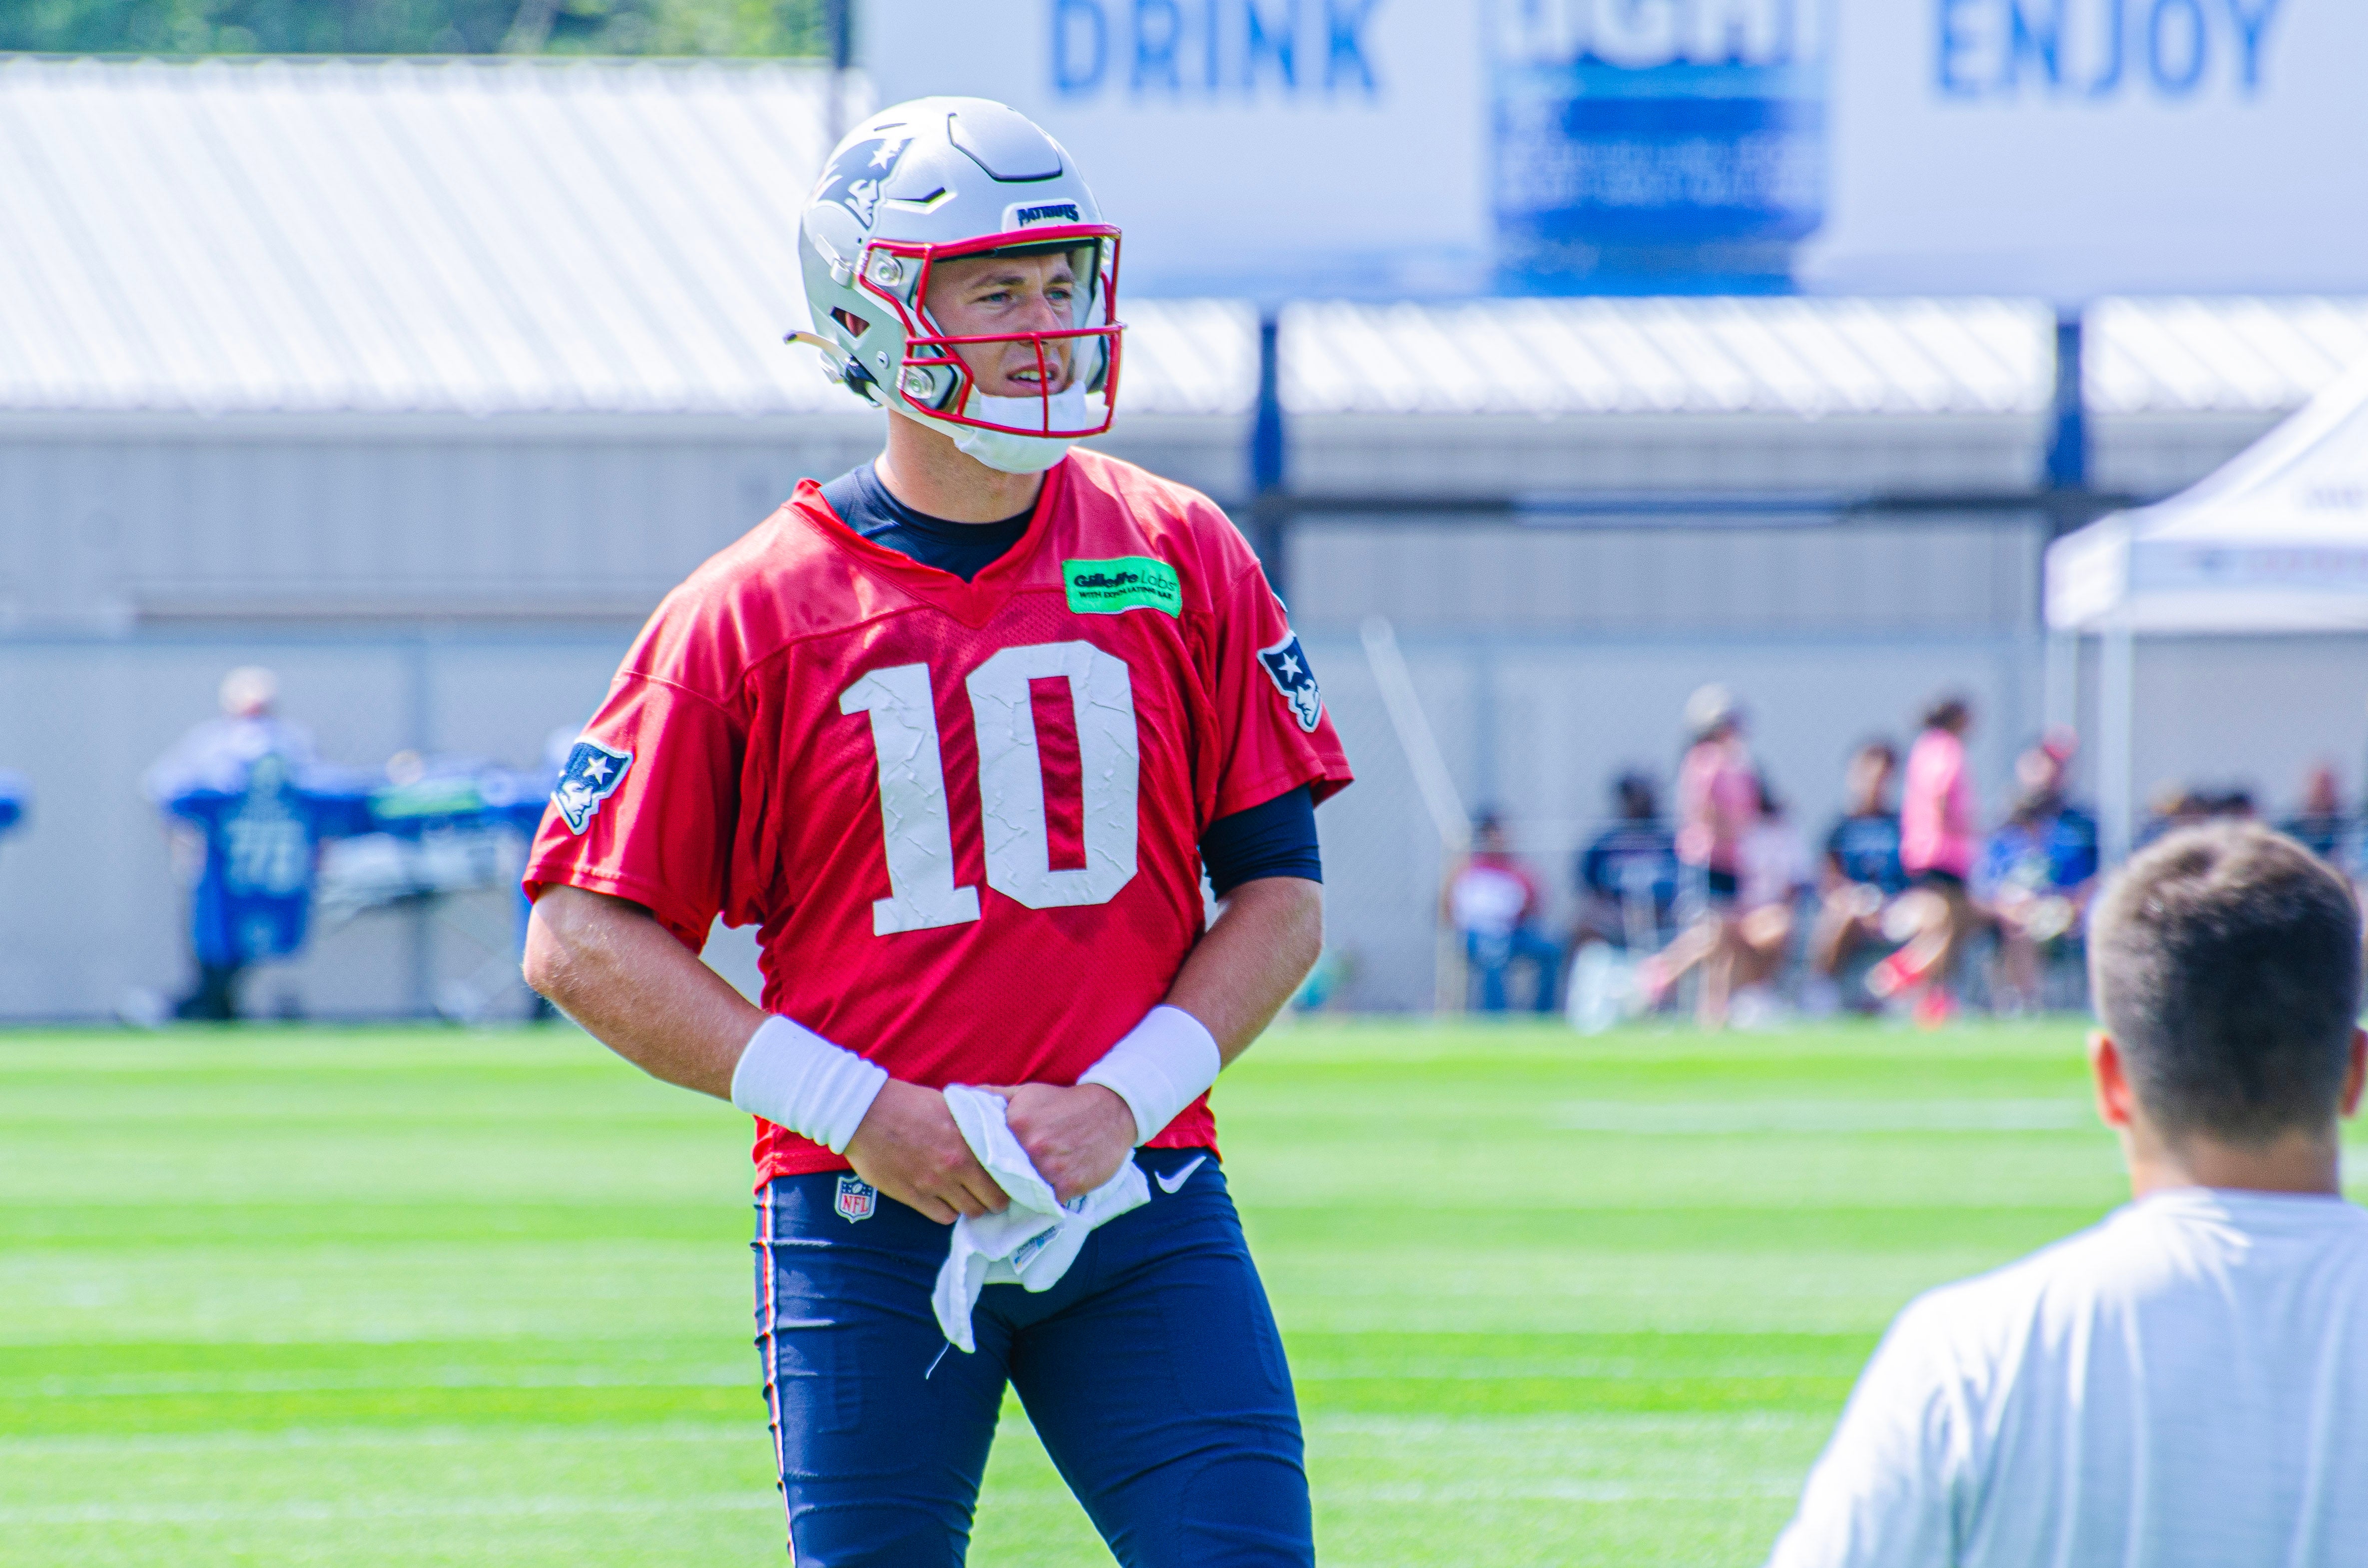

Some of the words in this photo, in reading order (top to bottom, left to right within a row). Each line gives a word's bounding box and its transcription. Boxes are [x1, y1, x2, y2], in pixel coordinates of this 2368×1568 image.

[1047, 0, 1381, 97] DRINK
[1933, 0, 2280, 97] ENJOY
[839, 640, 1140, 936] 10
[842, 1194, 869, 1214] NFL
